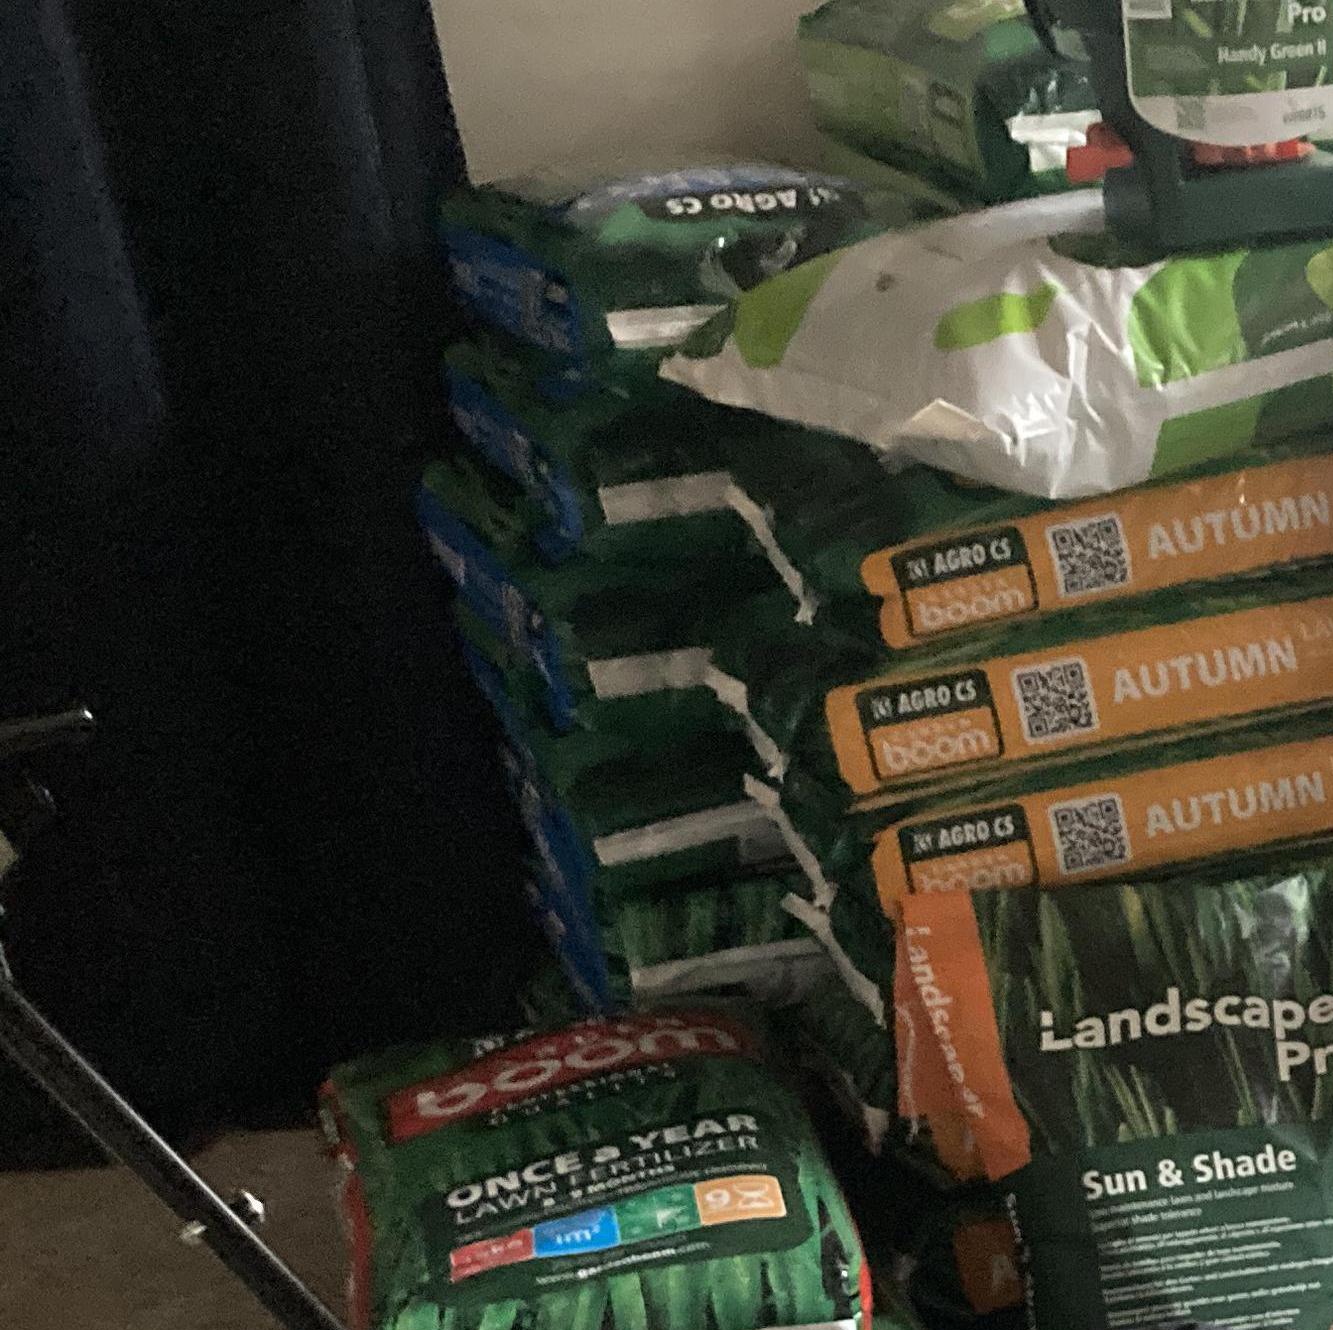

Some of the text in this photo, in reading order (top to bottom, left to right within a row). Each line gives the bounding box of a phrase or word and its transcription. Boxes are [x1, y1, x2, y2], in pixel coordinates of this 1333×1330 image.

[1288, 4, 1326, 26] Pro
[933, 536, 1013, 575] AGRO CS
[1147, 491, 1330, 561] AUTUMN
[899, 678, 978, 715] AGRO CS
[1112, 637, 1299, 704] AUTUMN
[937, 814, 1015, 850] AGRO CS
[1145, 770, 1327, 840] AUTUMN
[416, 1026, 738, 1118] boom
[446, 1150, 582, 1209] ONCE
[629, 1113, 759, 1150] YEAR
[1082, 1143, 1297, 1202] Sun & Shade
